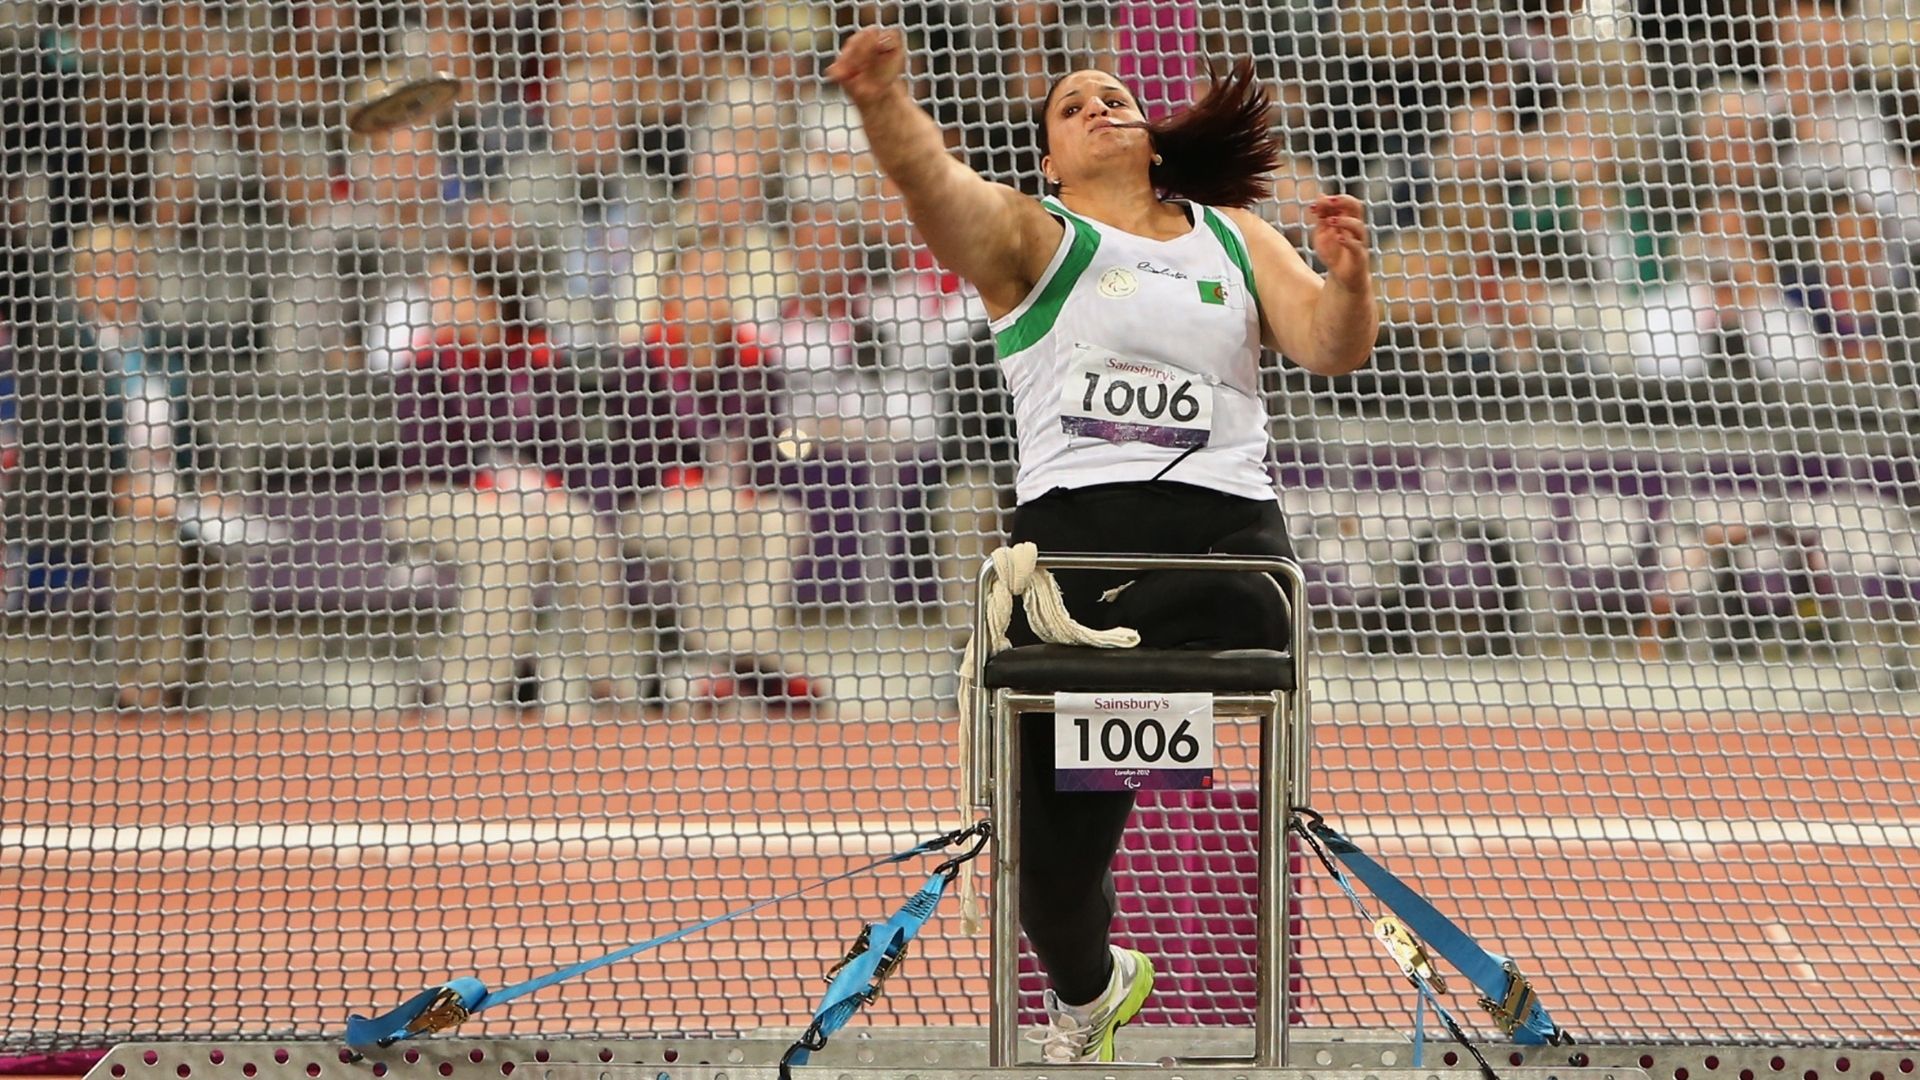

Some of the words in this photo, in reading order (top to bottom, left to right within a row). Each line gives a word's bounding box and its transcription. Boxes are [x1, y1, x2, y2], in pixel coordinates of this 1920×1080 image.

[1106, 358, 1176, 381] Sainsbury's
[1082, 372, 1200, 422] 1006
[1094, 698, 1169, 711] Sainsbury's
[1074, 718, 1199, 762] 1006
